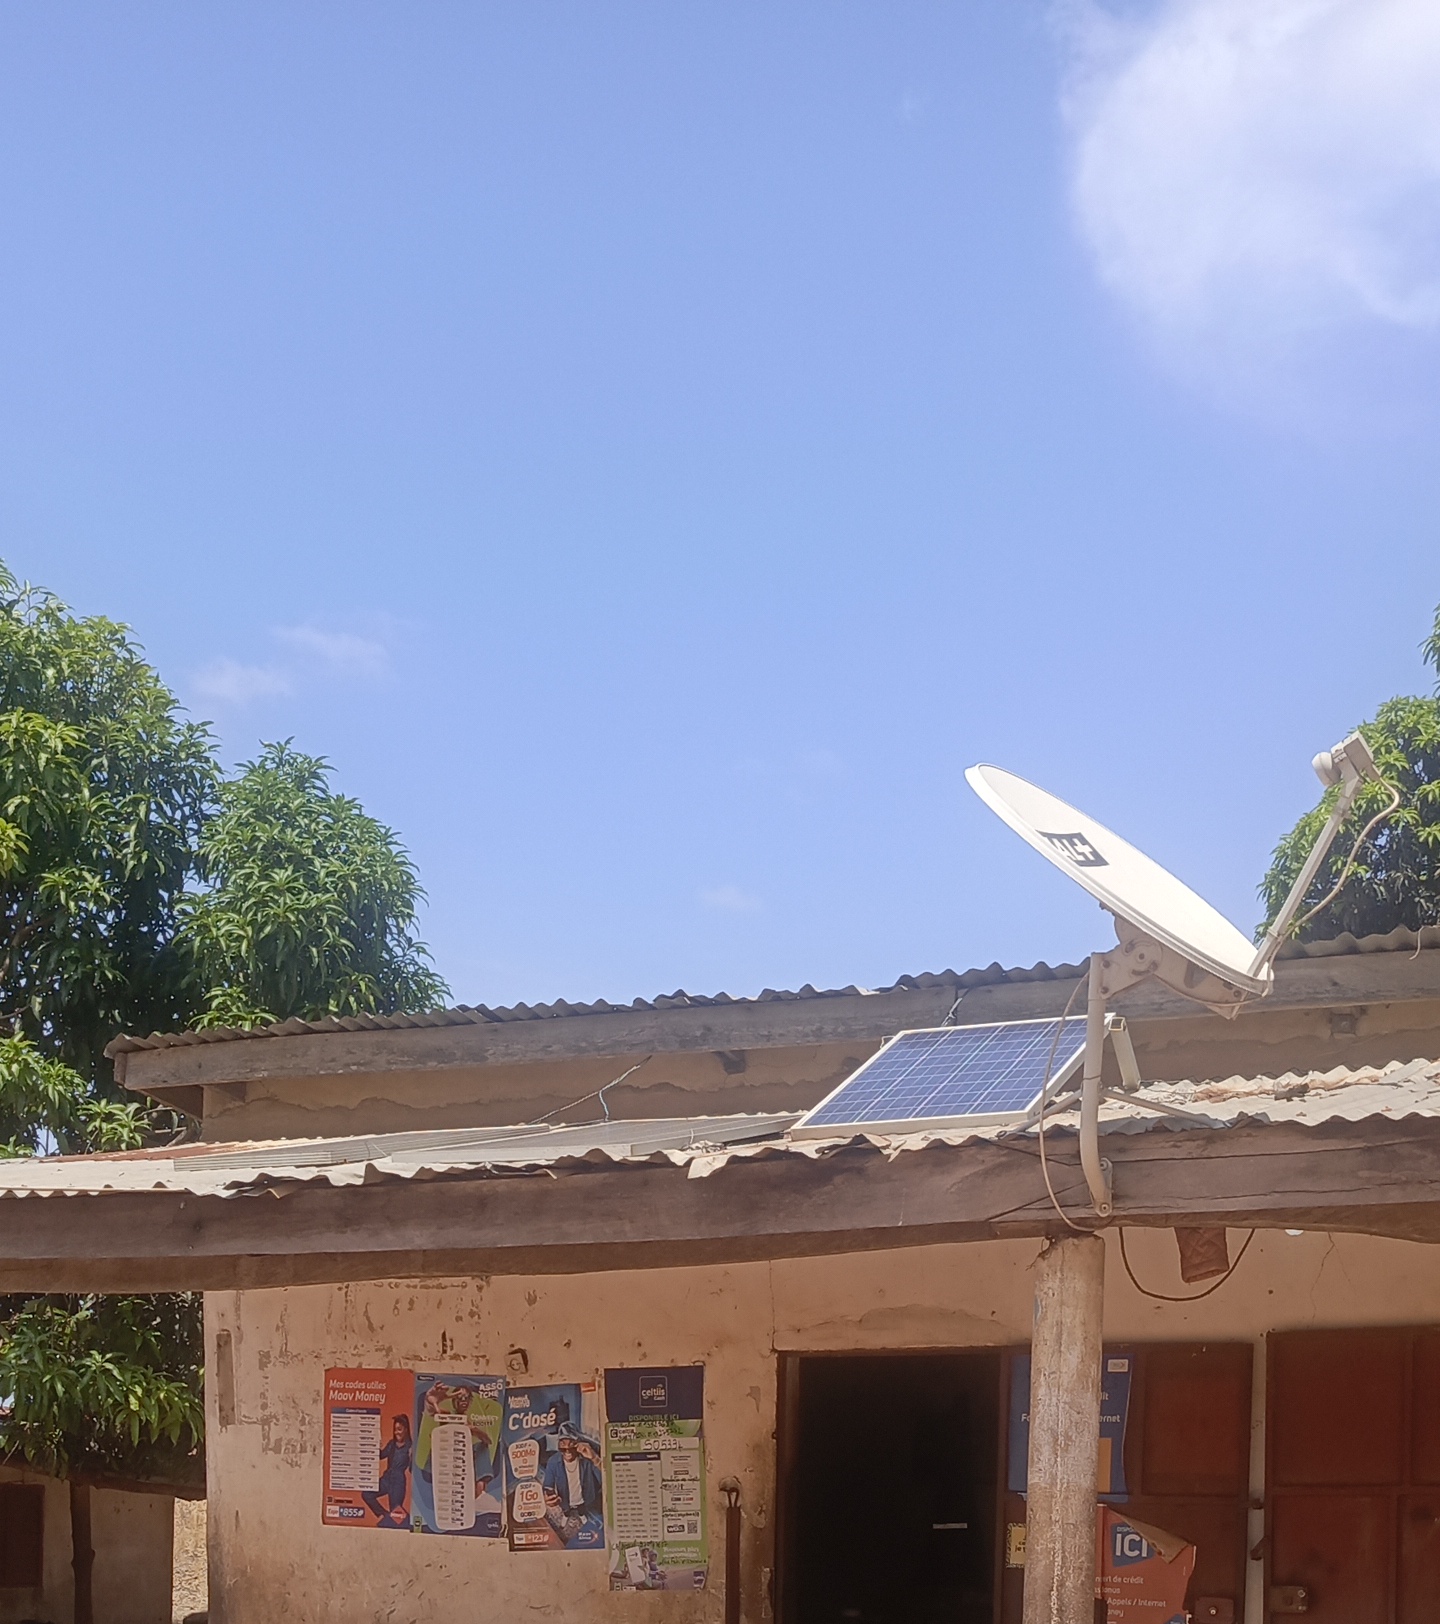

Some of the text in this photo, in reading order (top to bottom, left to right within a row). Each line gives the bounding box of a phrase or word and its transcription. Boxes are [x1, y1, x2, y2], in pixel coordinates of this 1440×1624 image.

[329, 1379, 387, 1390] Mes codes utiles
[329, 1390, 386, 1404] Moov Money
[508, 1407, 557, 1431] C'dosé
[519, 1490, 539, 1502] 1Go
[1115, 1532, 1149, 1558] ICI
[1122, 1575, 1144, 1585] crédit
[1106, 1597, 1132, 1607] Appels
[1138, 1598, 1167, 1608] Internet
